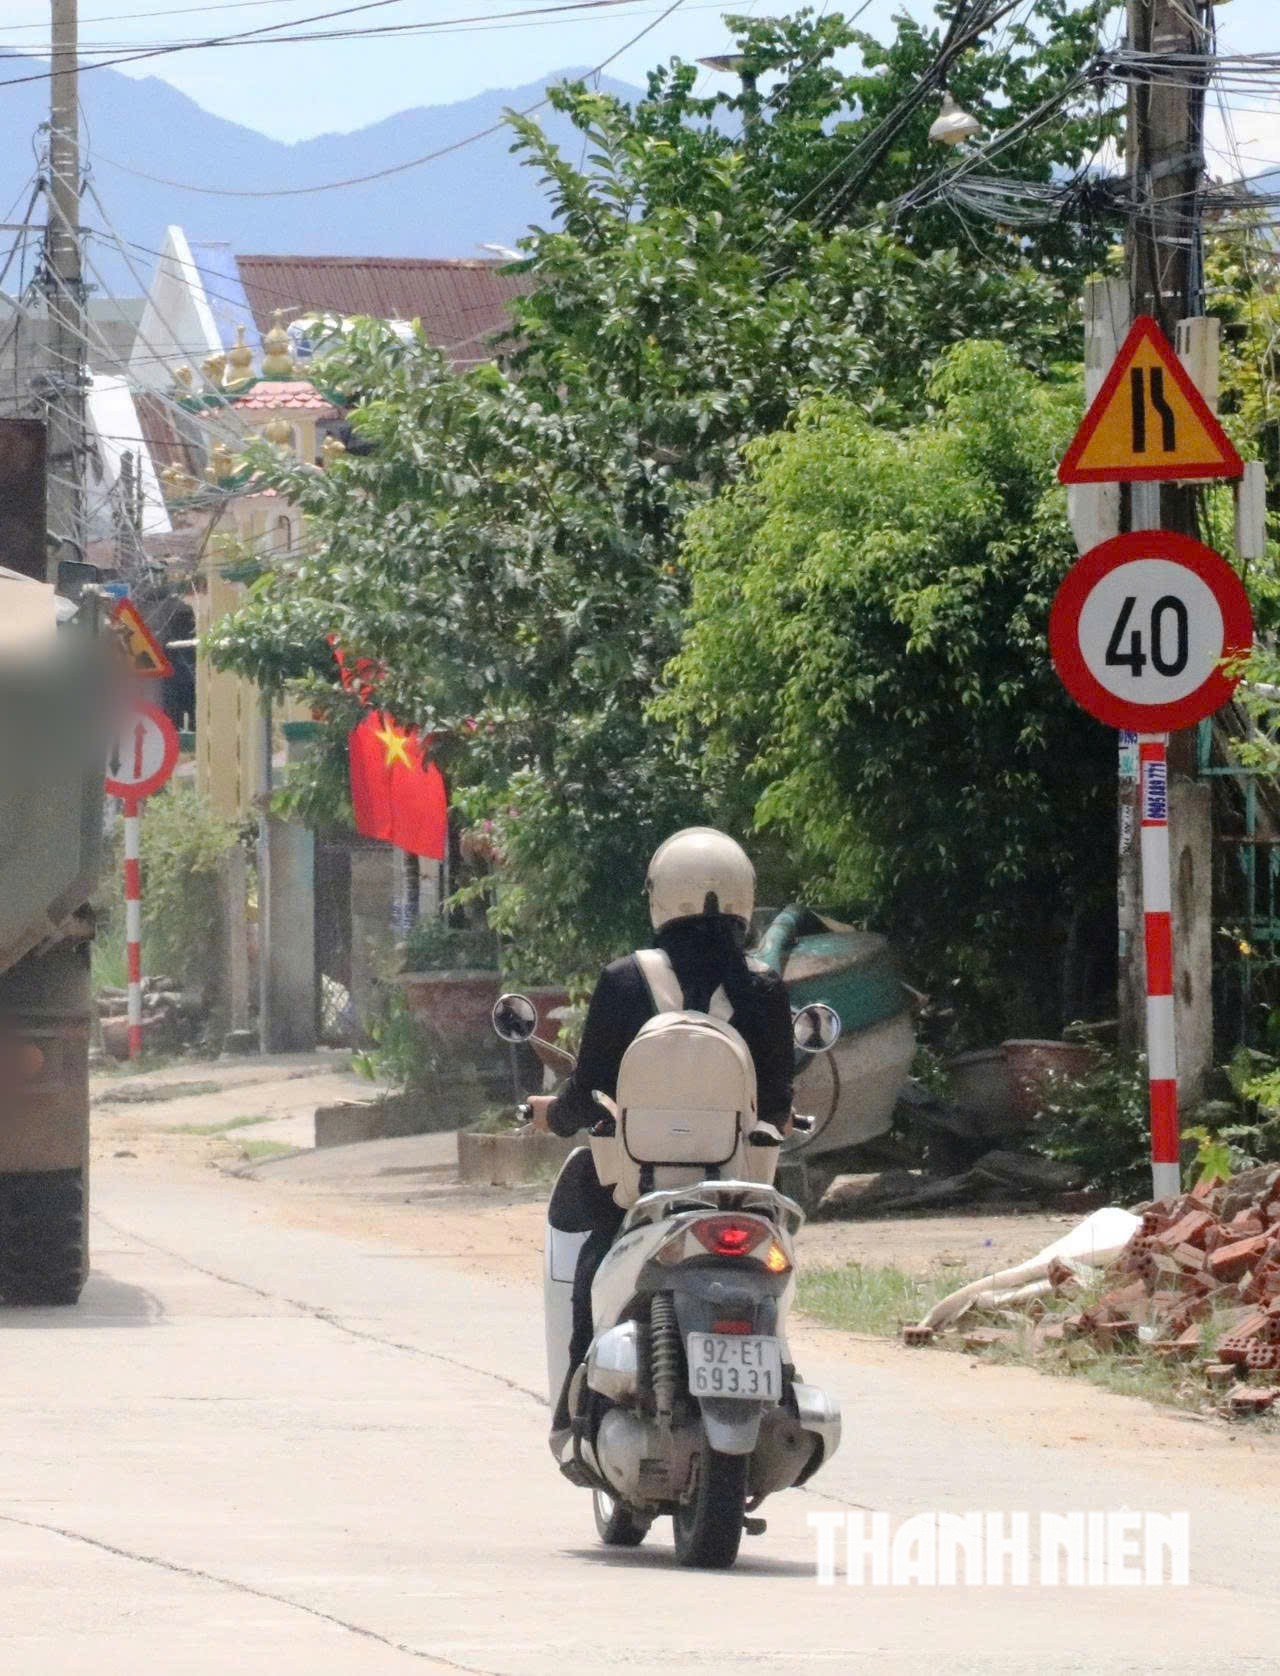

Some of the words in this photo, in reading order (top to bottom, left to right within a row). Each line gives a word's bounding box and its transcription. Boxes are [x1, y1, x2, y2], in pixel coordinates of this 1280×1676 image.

[1104, 595, 1189, 678] 40
[702, 1338, 764, 1366] 92-E1
[695, 1366, 772, 1395] 693.31
